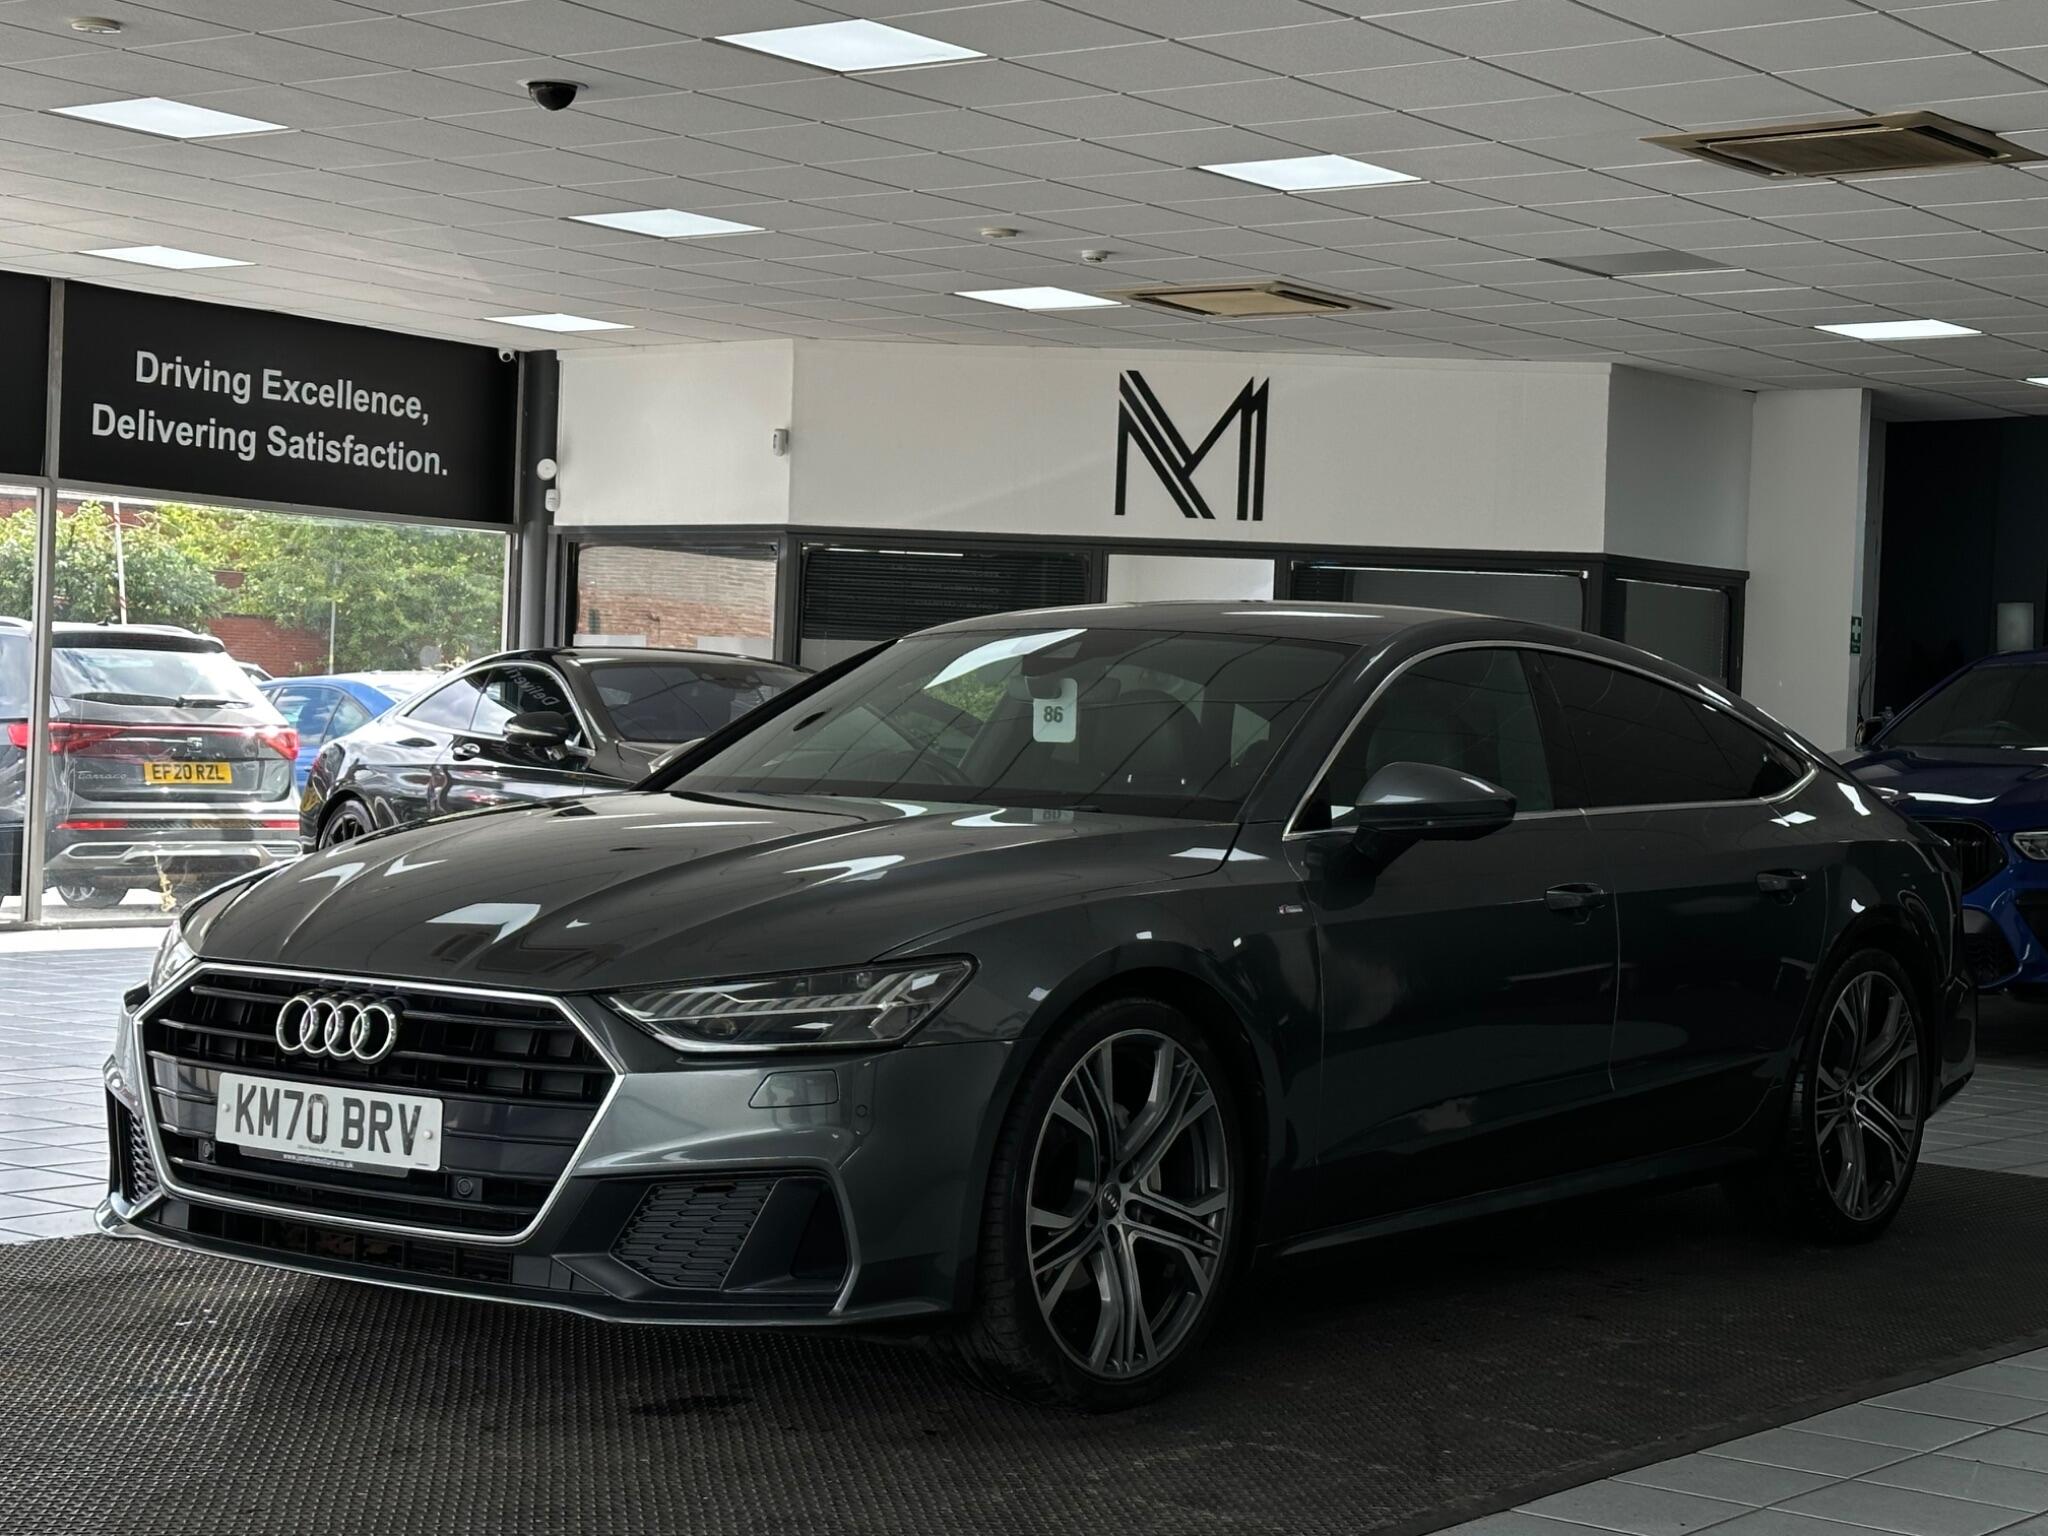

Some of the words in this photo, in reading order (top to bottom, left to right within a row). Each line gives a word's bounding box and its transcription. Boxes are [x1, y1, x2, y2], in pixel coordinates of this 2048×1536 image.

[136, 350, 251, 405] Driving
[262, 368, 429, 426] Excellence,
[92, 402, 257, 462] Delivering
[266, 425, 448, 476] Satisfaction.
[1043, 705, 1063, 723] 86
[152, 763, 192, 780] EF20
[196, 763, 225, 780] RZL
[235, 1083, 329, 1145] KM70
[341, 1097, 422, 1156] BRV
